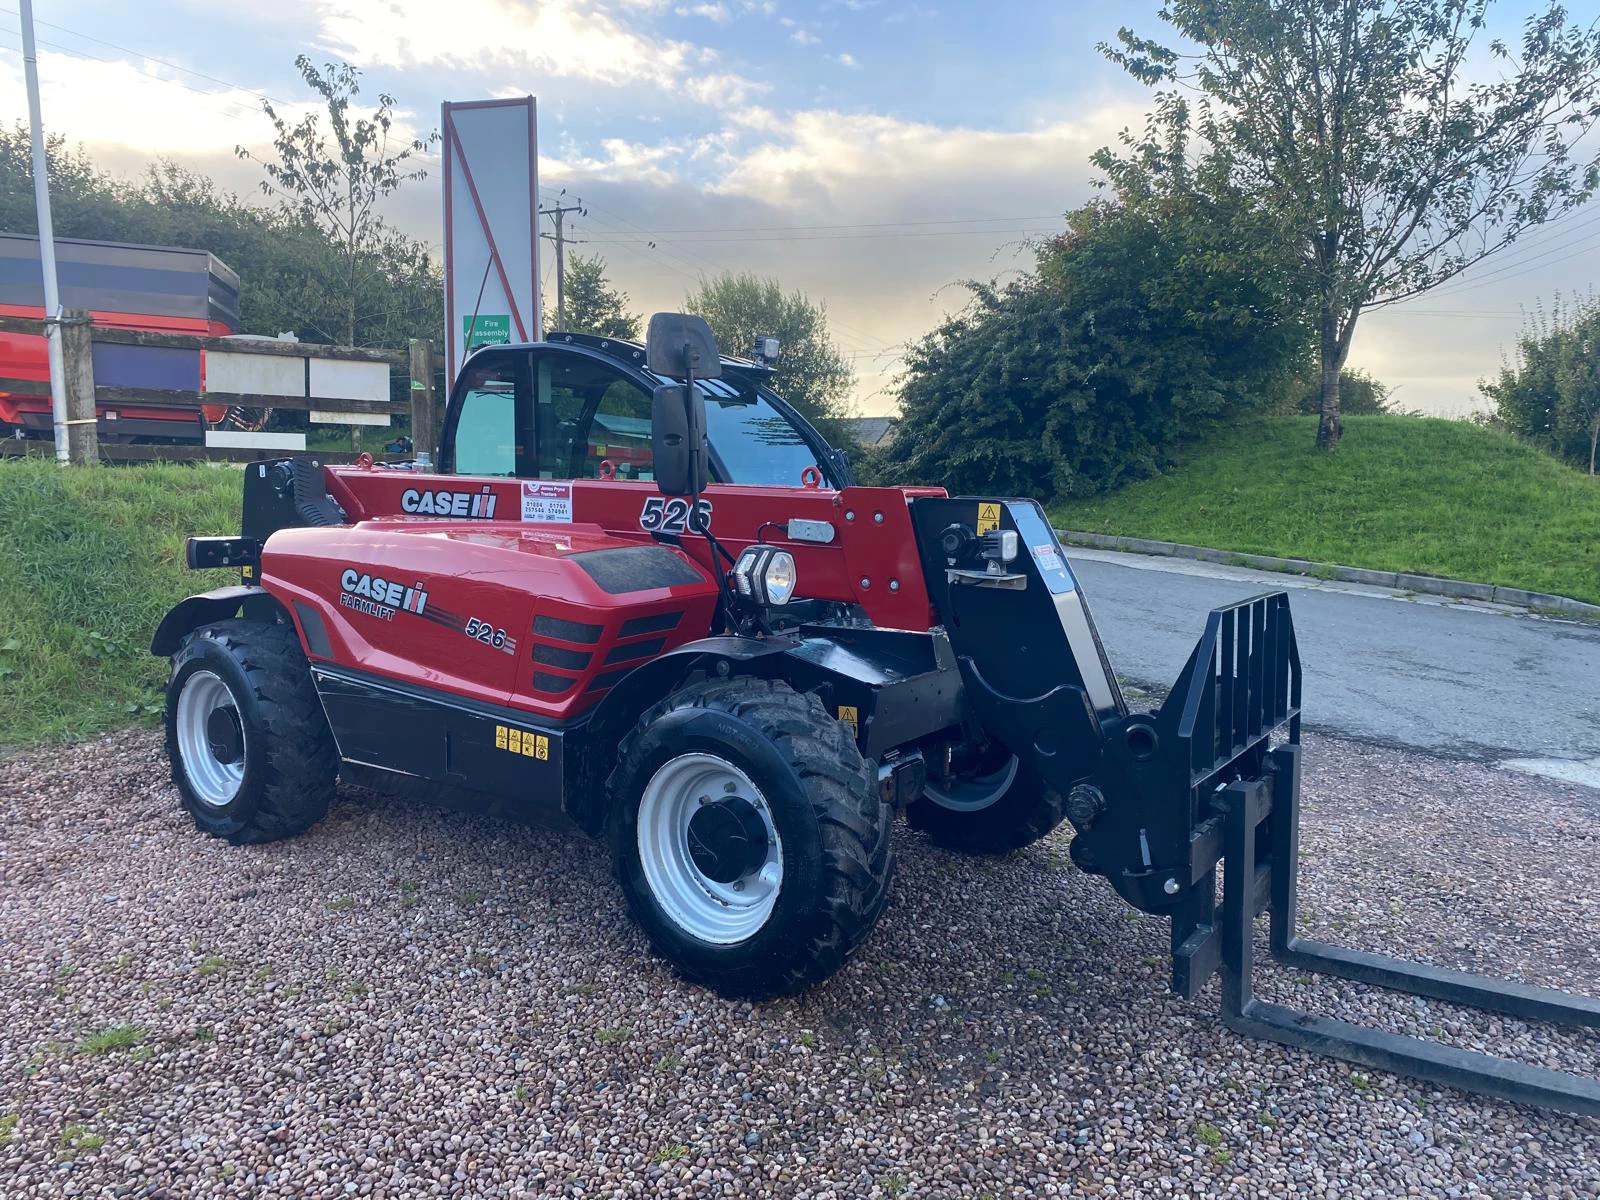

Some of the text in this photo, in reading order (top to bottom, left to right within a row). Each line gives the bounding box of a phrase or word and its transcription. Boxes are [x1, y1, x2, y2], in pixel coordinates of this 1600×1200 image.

[475, 329, 509, 338] assembly
[401, 488, 470, 516] CASE
[640, 496, 714, 535] 526
[341, 568, 403, 607] CASE
[340, 592, 395, 622] FARMLIFT
[465, 616, 507, 650] 526
